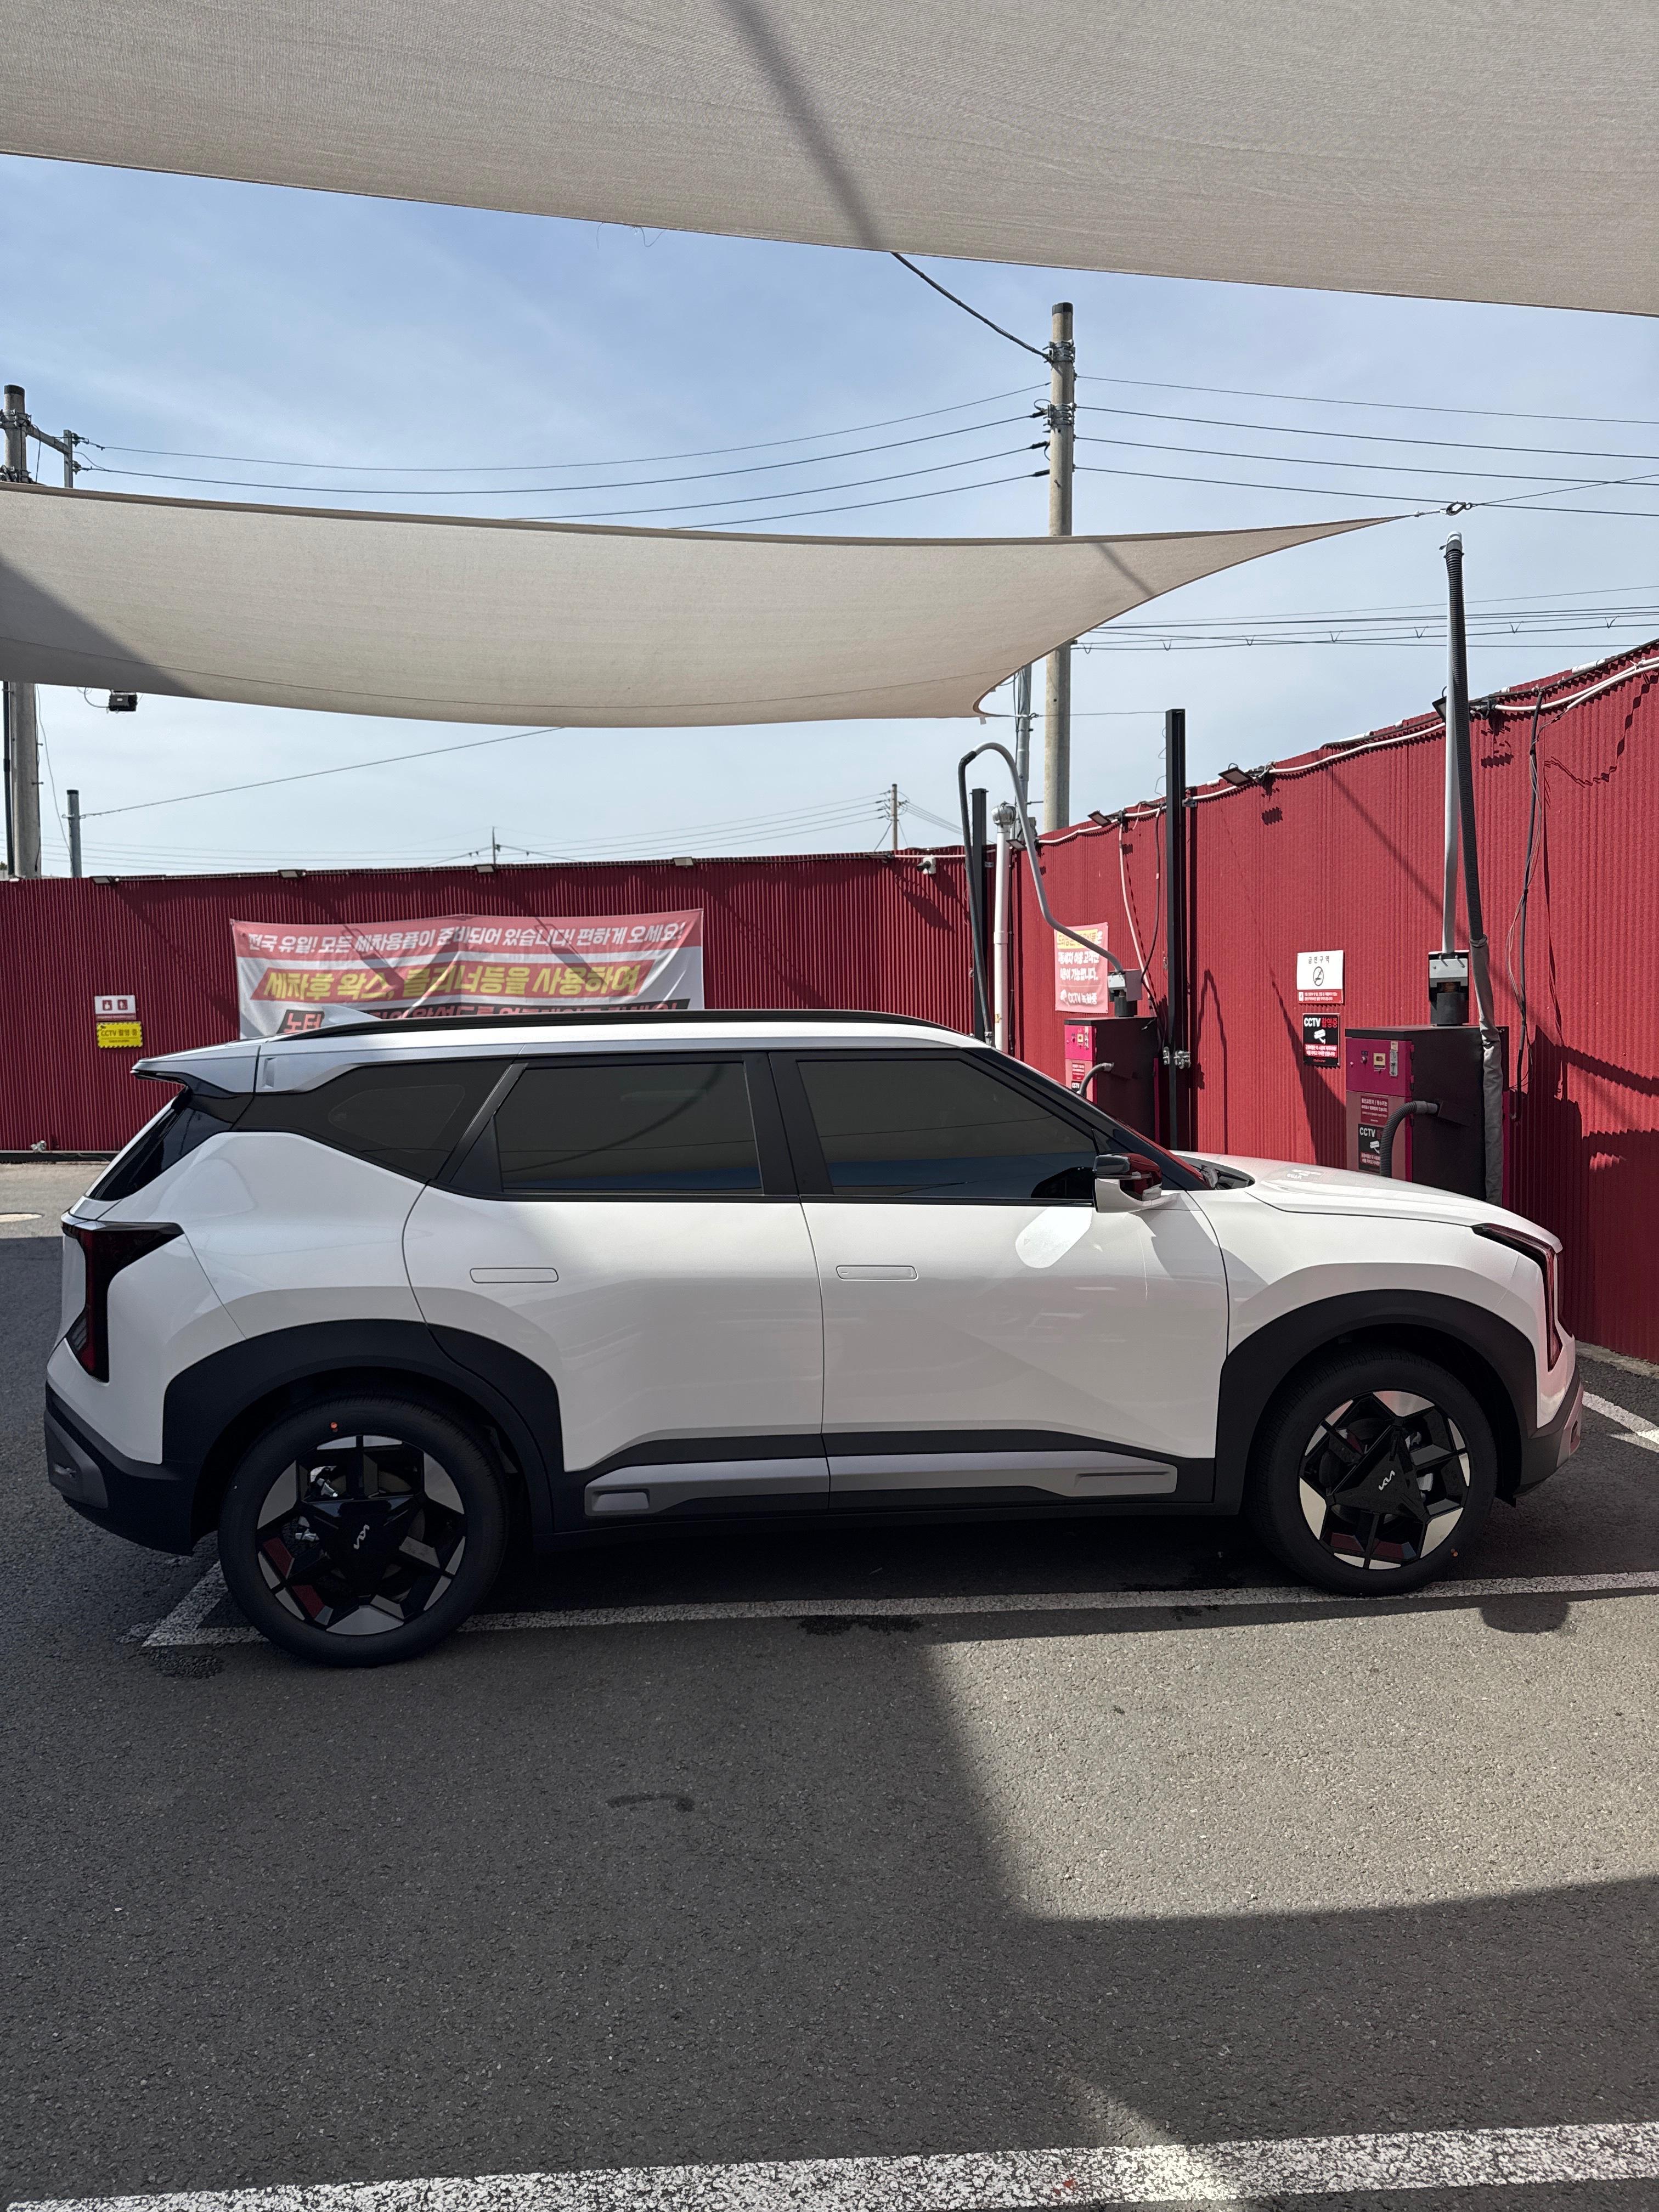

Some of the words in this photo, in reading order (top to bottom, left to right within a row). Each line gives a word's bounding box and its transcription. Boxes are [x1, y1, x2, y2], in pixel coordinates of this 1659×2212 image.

[249, 933, 278, 952] 전국
[279, 935, 319, 954] 유일!
[318, 935, 353, 953] 모든
[353, 929, 436, 953] 세차용품이
[437, 926, 503, 946] 준비되어
[503, 928, 573, 946] 있습니다!
[575, 926, 628, 946] 편하게
[627, 922, 686, 944] 오세요!
[1308, 956, 1330, 964] 금연구역
[263, 972, 334, 1000] 세차후
[337, 972, 394, 1000] 왁스,
[403, 965, 531, 997] 클리너등을
[532, 964, 641, 995] 사용하여
[1068, 992, 1082, 1004] CCTV
[1304, 1018, 1321, 1027] CCTV
[1322, 1018, 1338, 1028] 촬영중
[1359, 1127, 1375, 1137] CCTV
